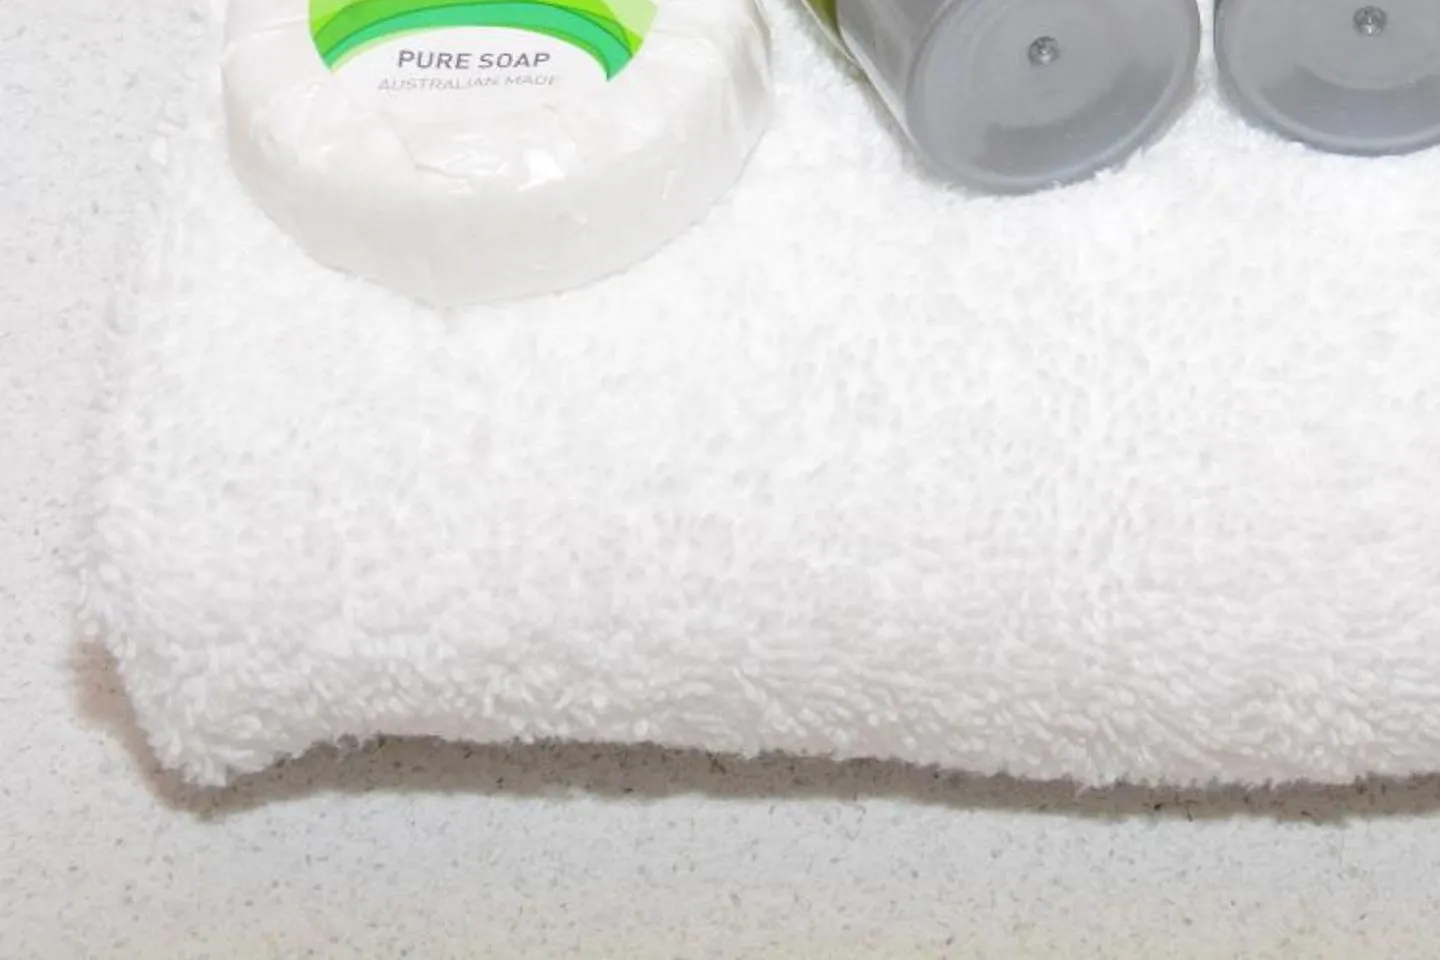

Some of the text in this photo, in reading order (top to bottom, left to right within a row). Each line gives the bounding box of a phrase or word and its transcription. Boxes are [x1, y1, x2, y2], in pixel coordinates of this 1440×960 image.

[397, 49, 550, 70] PURE SOAP
[378, 73, 560, 91] AUSTRALIAN MADE
